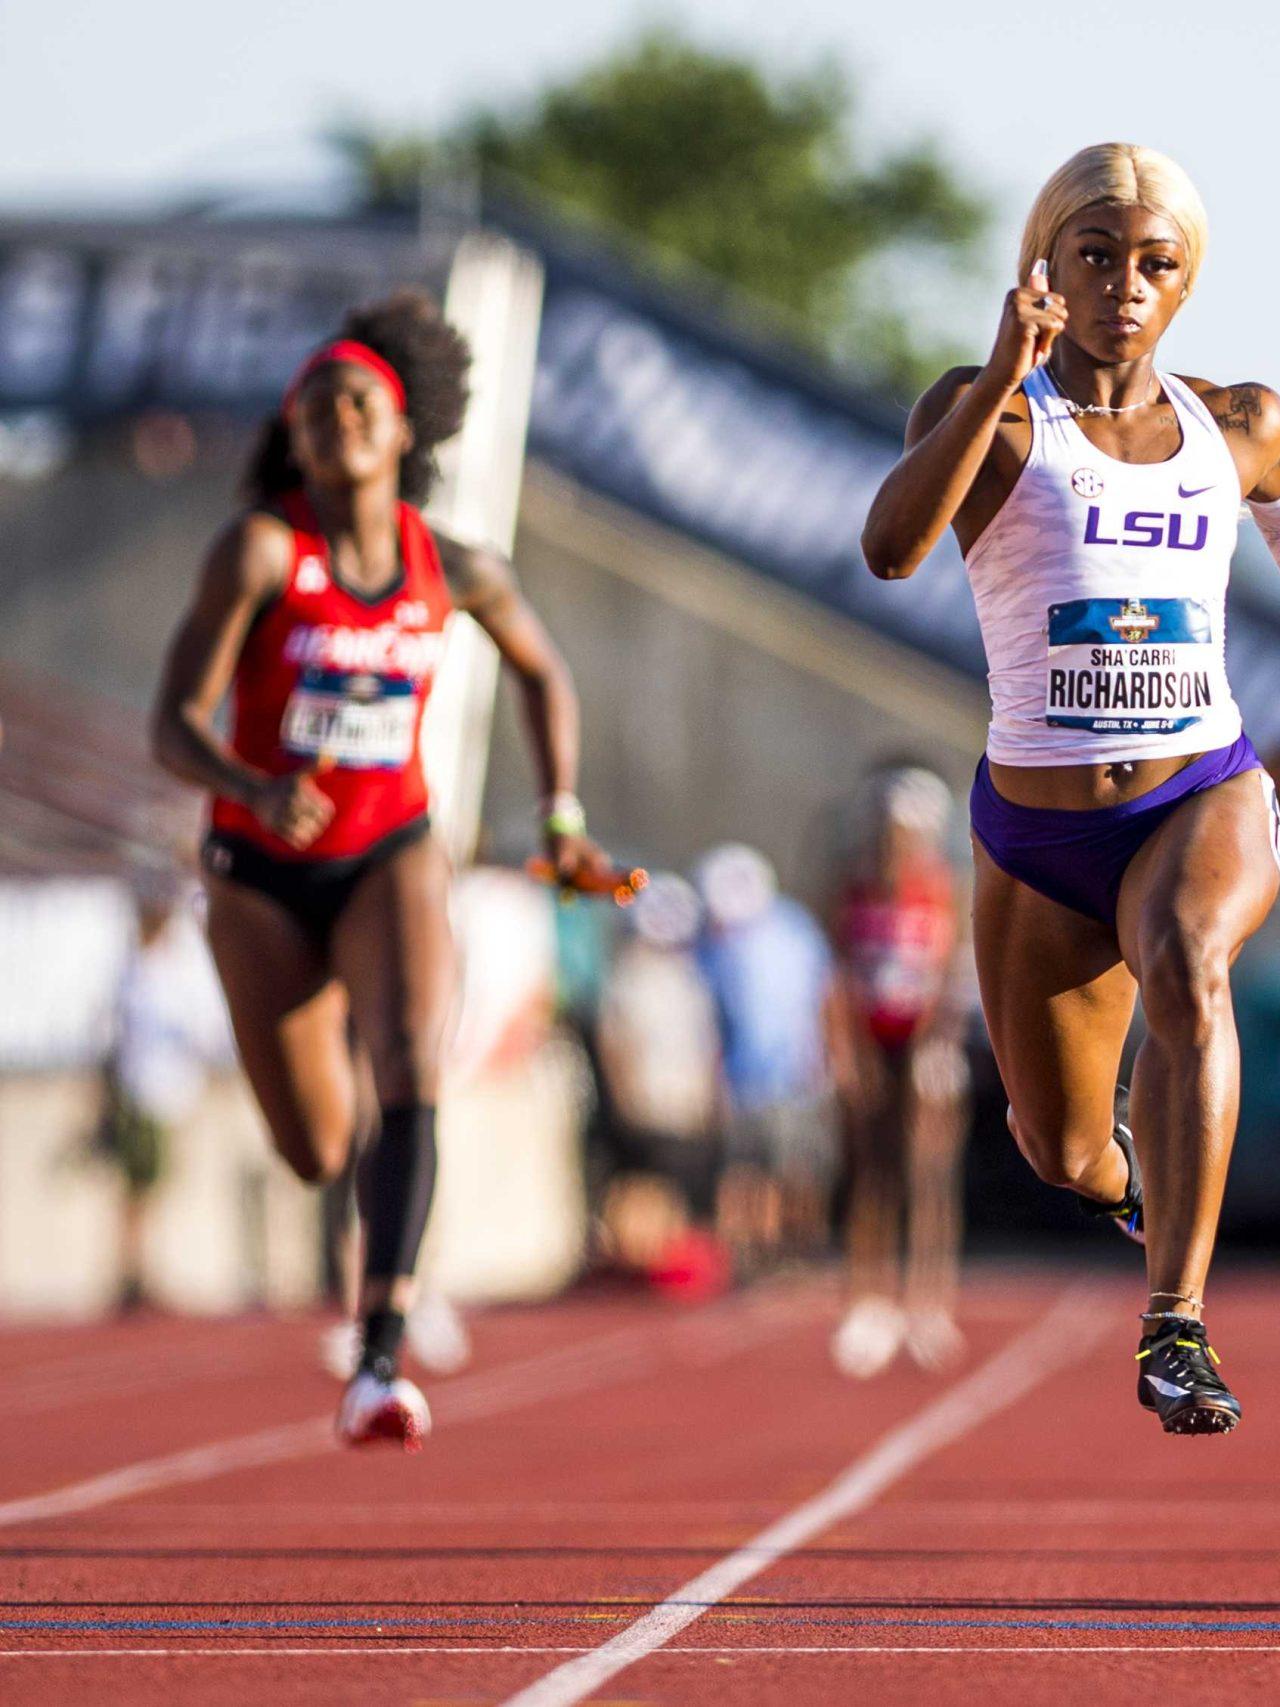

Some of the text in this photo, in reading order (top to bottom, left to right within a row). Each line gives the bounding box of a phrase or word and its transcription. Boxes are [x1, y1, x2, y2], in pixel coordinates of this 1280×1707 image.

[1083, 505, 1209, 550] LSU
[1049, 668, 1212, 709] RICHARDSON
[1123, 720, 1133, 729] TX
